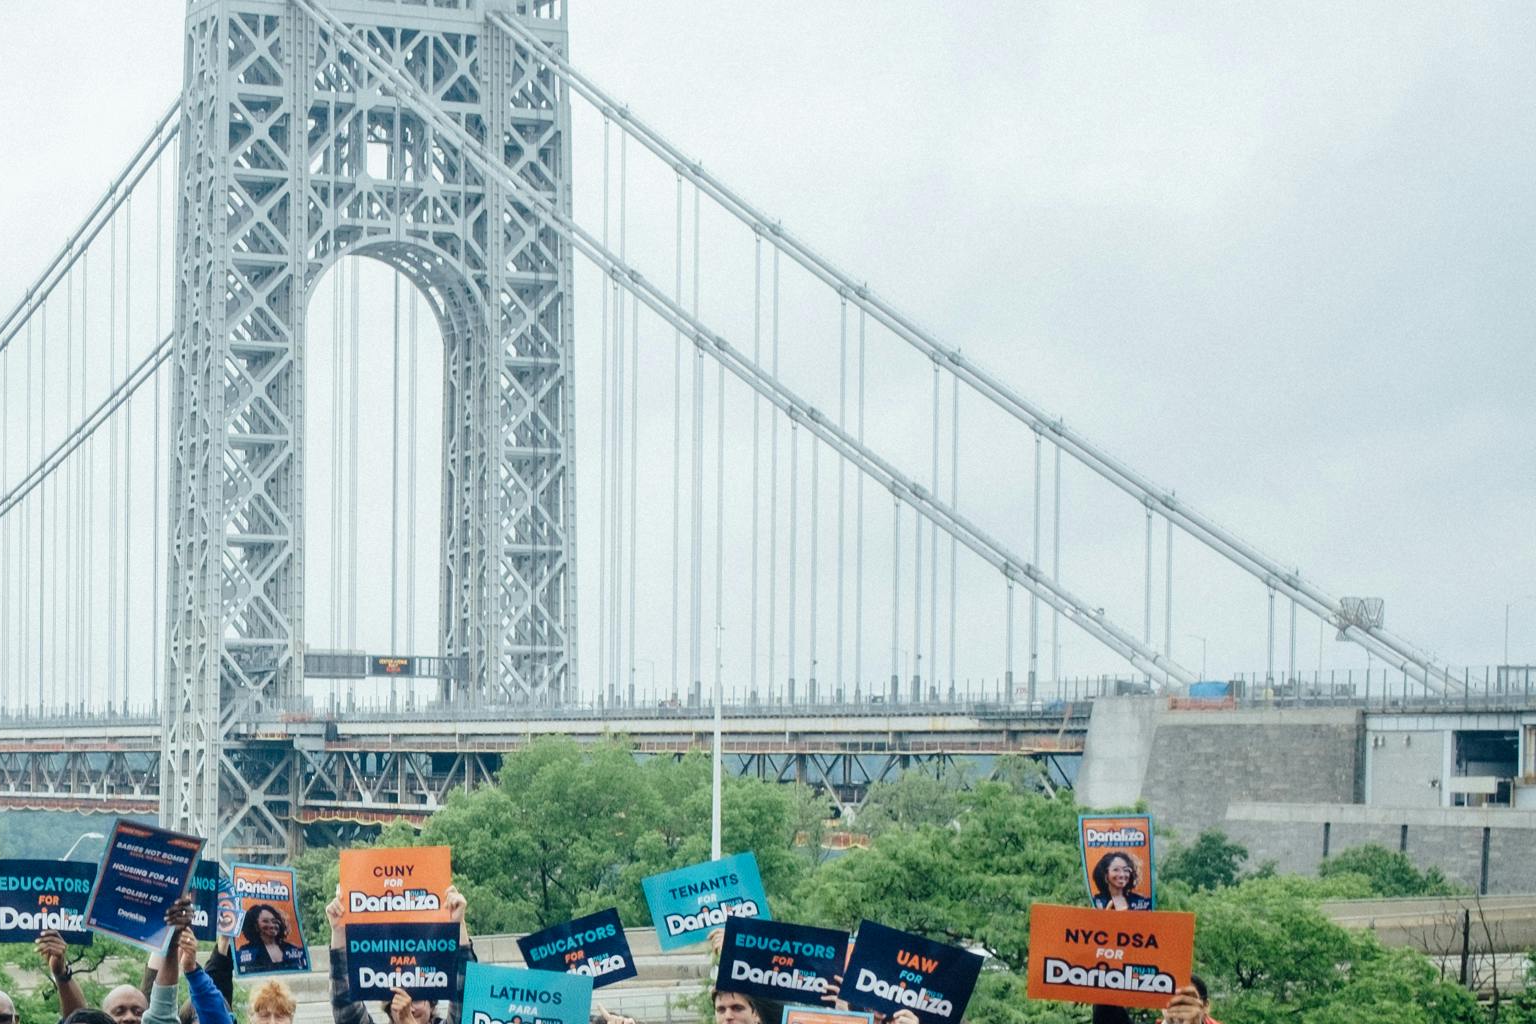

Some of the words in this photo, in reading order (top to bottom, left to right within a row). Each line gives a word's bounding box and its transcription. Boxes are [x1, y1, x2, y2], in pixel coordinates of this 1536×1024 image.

[112, 862, 148, 877] HOUSING
[148, 871, 165, 881] FOR
[165, 876, 179, 886] ALL
[373, 865, 415, 878] CUNY
[237, 878, 289, 896] Darializa
[384, 879, 404, 888] FOR
[669, 873, 739, 900] TENANTS
[38, 895, 60, 906] FOR
[350, 890, 440, 912] Darializa
[697, 893, 718, 906] FOR
[666, 899, 759, 936] Darializa
[350, 939, 457, 953] DOMINICANOS
[529, 923, 616, 962] EDUCATORS
[735, 933, 835, 960] EDUCATORS
[1065, 929, 1109, 945] NYC
[1116, 933, 1159, 949] DSA
[390, 956, 417, 965] PARA
[565, 949, 585, 964] FOR
[771, 955, 794, 966] FOR
[896, 949, 940, 974] UAW
[1096, 948, 1124, 960] FOR
[359, 966, 448, 988] Darializa
[731, 960, 829, 993] Darializa
[899, 970, 923, 984] FOR
[1045, 958, 1174, 993] Darializa
[490, 985, 562, 1005] LATINOS
[855, 968, 953, 1018] Darializa
[509, 1004, 538, 1016] PARA
